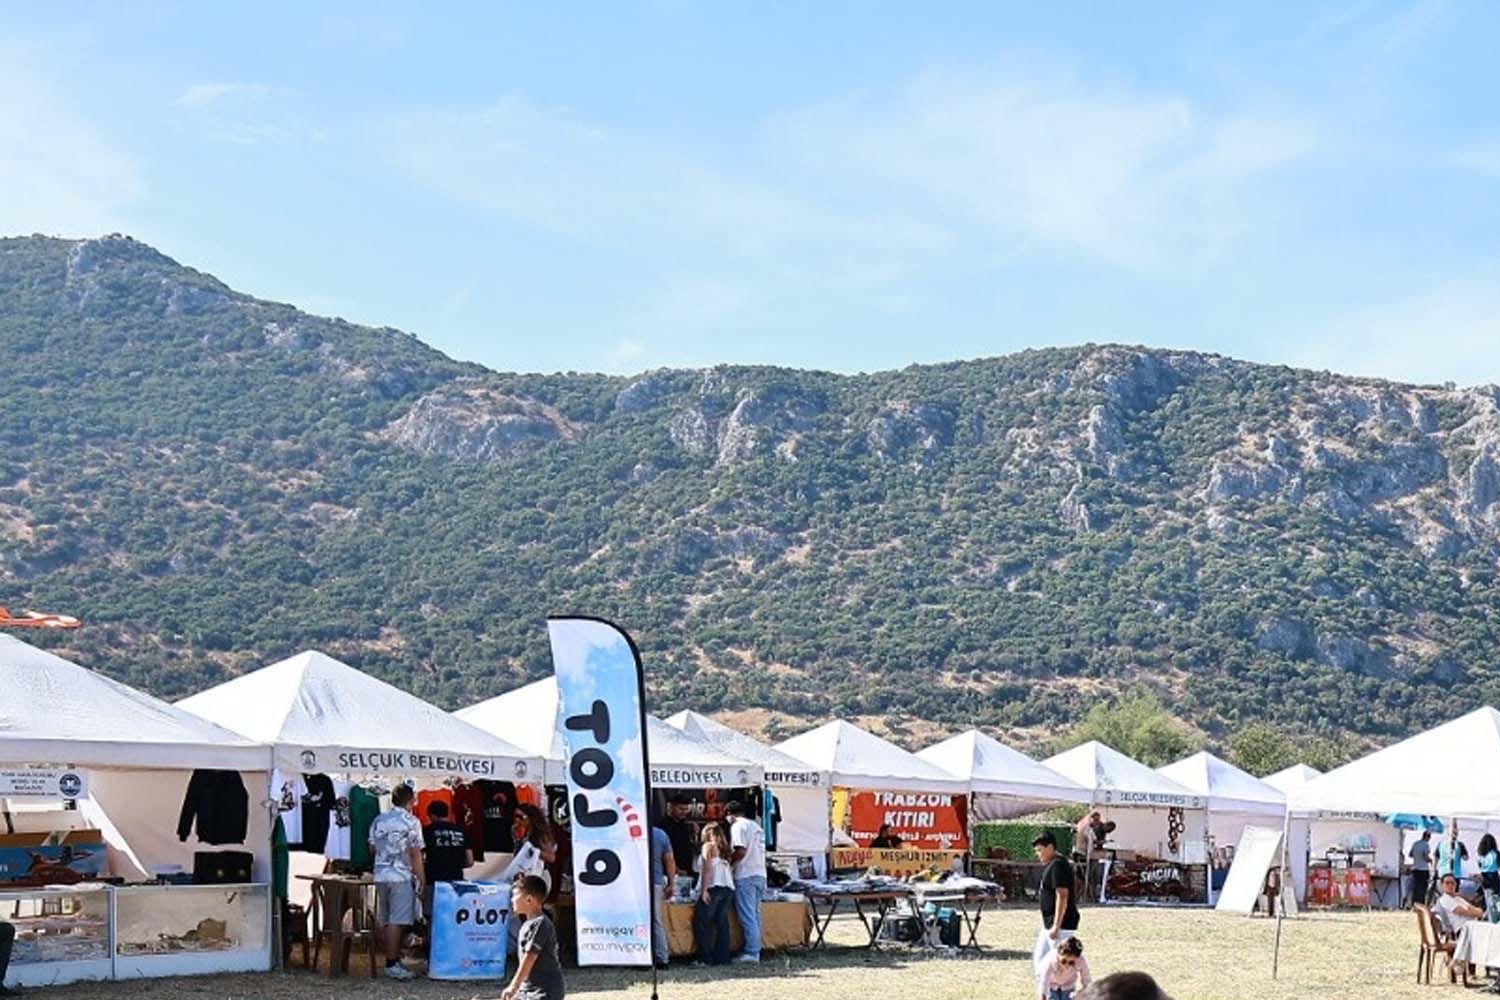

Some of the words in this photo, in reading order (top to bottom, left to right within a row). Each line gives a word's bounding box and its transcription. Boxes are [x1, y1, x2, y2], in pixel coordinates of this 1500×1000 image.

[339, 753, 404, 771] SELÇUK
[873, 791, 952, 807] TRABZON
[884, 811, 935, 828] KITIRI
